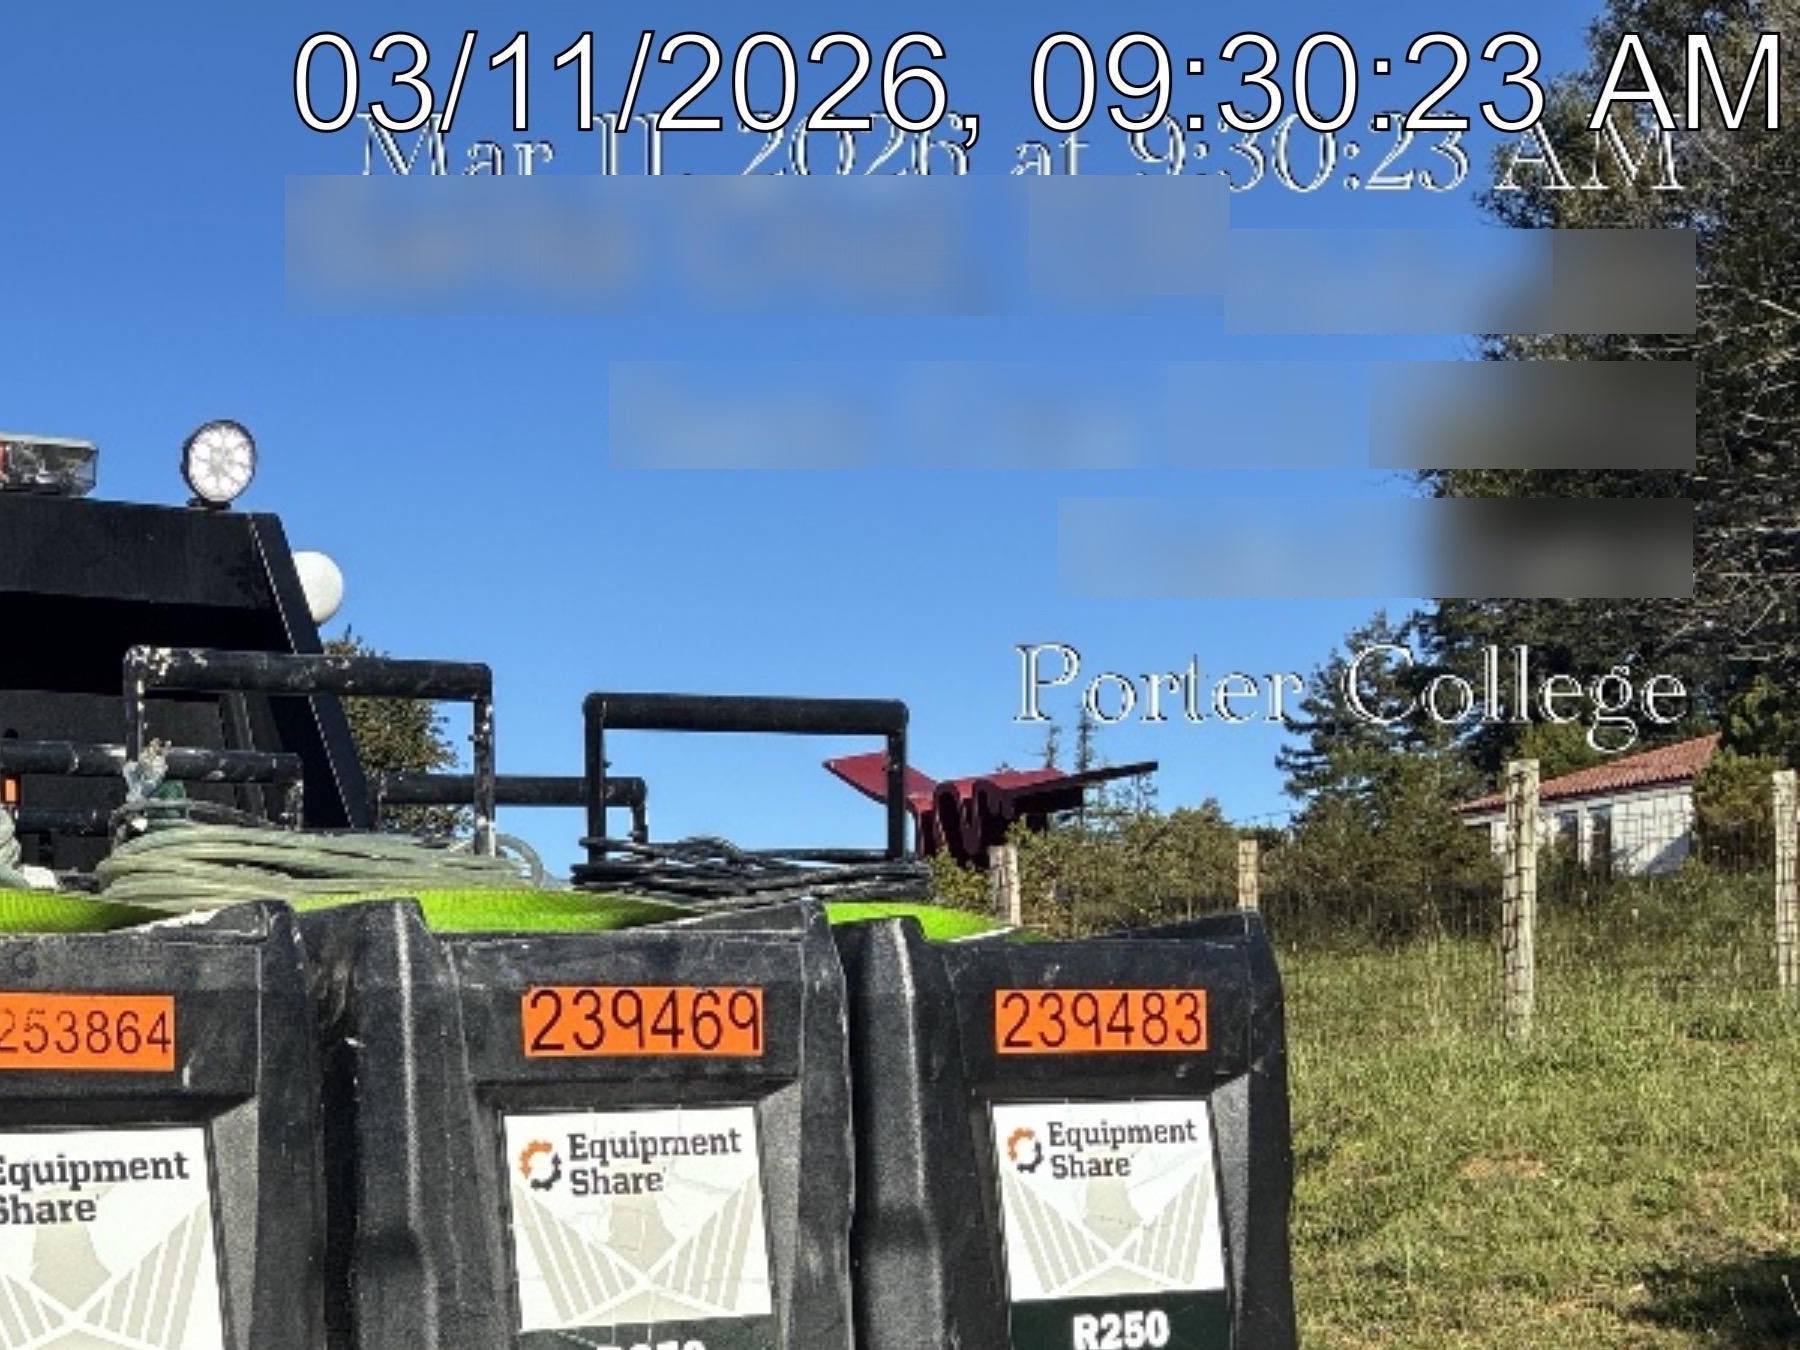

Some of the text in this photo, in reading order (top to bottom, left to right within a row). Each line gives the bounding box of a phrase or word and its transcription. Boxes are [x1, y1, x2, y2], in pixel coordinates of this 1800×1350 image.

[529, 989, 761, 1052] 239469
[1000, 992, 1205, 1050] 239483
[569, 1128, 742, 1160] Equipment
[1048, 1120, 1198, 1149] Equipment
[1052, 1153, 1132, 1177] Share
[571, 1168, 663, 1195] Share
